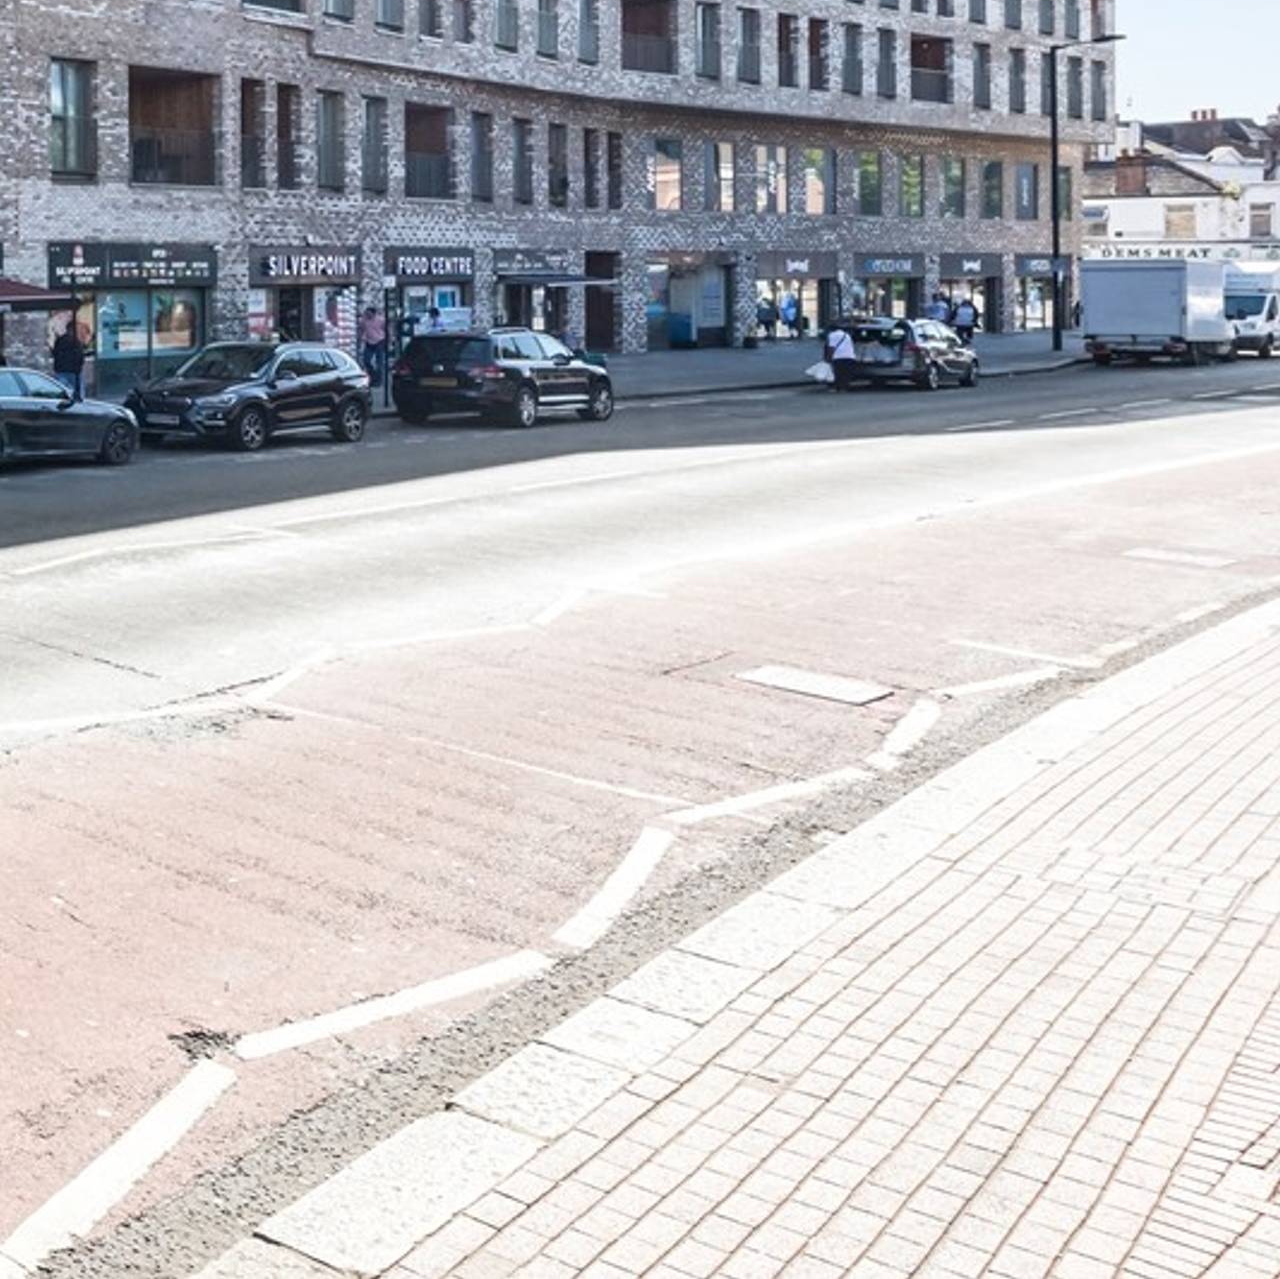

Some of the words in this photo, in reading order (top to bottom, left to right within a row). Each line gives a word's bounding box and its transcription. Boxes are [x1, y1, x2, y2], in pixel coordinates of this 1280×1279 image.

[1102, 247, 1152, 258] DEMS
[1158, 247, 1211, 258] MEAT
[269, 256, 356, 276] SILVERPOINT
[398, 256, 428, 275] FOOD
[430, 256, 472, 275] CENTRE
